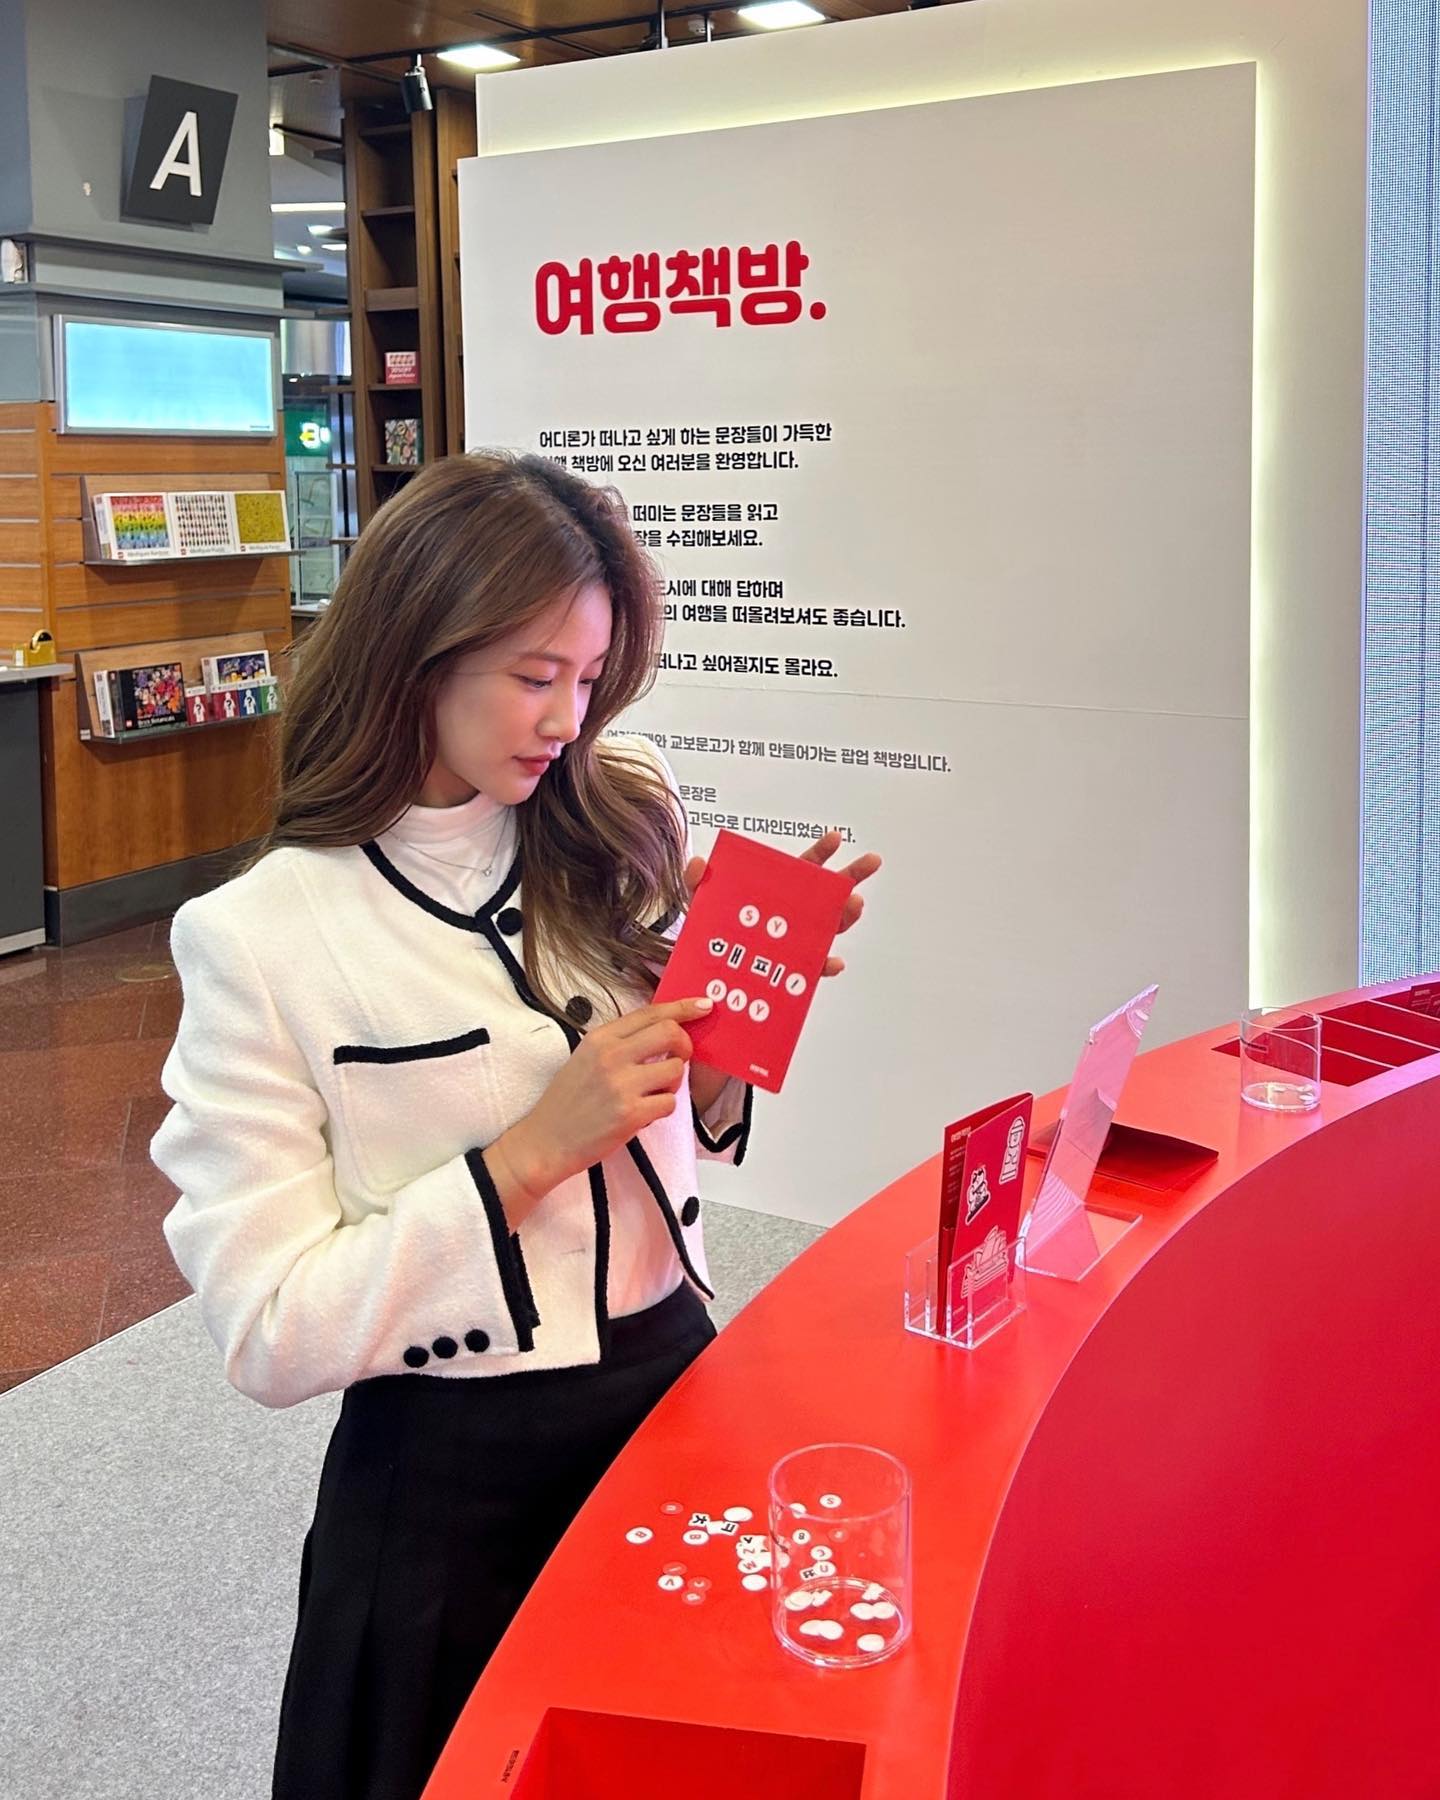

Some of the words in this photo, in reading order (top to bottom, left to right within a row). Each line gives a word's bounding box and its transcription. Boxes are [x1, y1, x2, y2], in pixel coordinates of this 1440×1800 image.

[149, 111, 202, 197] A
[535, 240, 826, 335] 여행책방.
[539, 430, 596, 448] 어디론가
[599, 429, 642, 447] 떠나고
[646, 428, 676, 446] 싶게
[680, 427, 710, 445] 하는
[715, 424, 778, 444] 문장들이
[782, 422, 832, 442] 가득한
[571, 454, 614, 472] 책방에
[617, 453, 646, 472] 오신
[651, 452, 711, 472] 여러분을
[715, 450, 799, 471] 환영합니다.
[633, 505, 676, 522] 떠미는
[681, 503, 742, 522] 문장들을
[747, 503, 779, 521] 읽고
[666, 529, 764, 548] 수집해보세요.
[701, 579, 732, 597] 대해
[736, 580, 783, 599] 답하며
[682, 604, 728, 623] 여행을
[732, 605, 829, 626] 떠올려보셔도
[832, 608, 906, 628] 좋습니다.
[702, 654, 780, 675] 싶어질지도
[785, 657, 838, 678] 몰라요.
[670, 735, 735, 755] 교보문고가
[738, 740, 766, 757] 함께
[769, 743, 837, 764] 만들어가는
[841, 748, 869, 766] 팝업
[873, 751, 952, 773] 책방입니다.
[679, 784, 718, 803] 문장은
